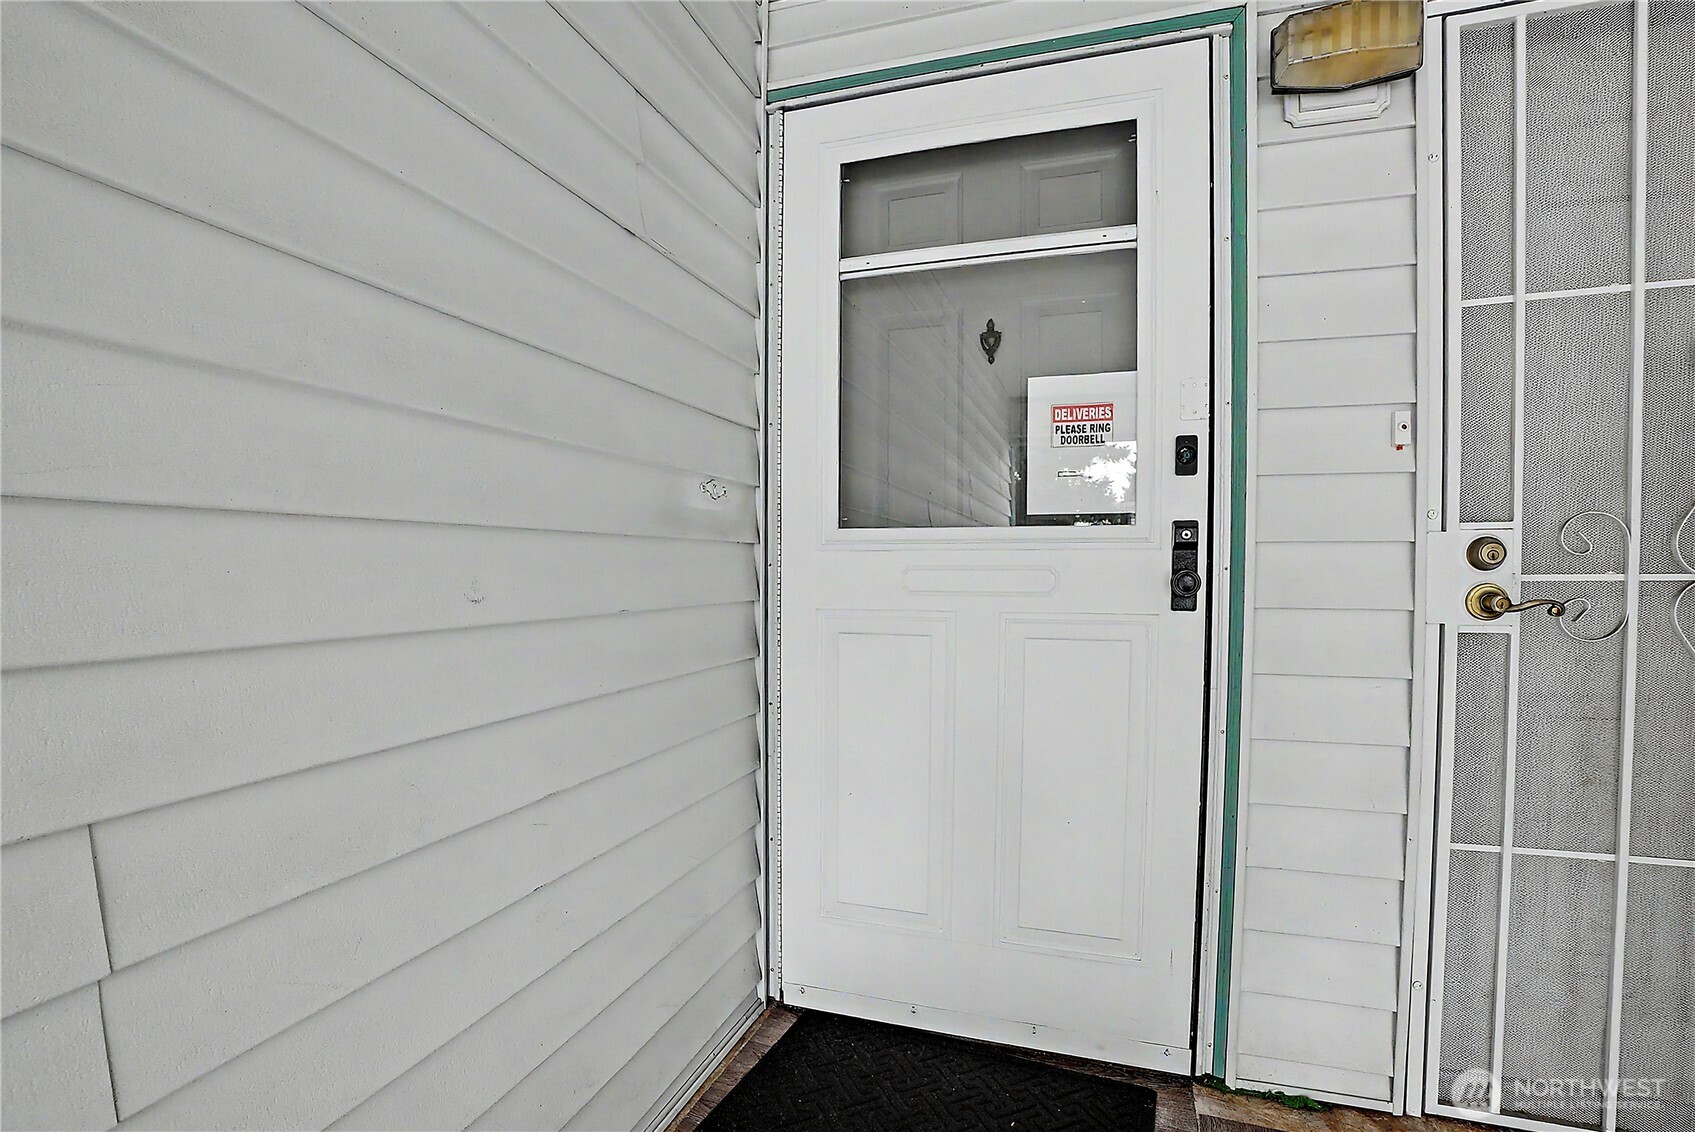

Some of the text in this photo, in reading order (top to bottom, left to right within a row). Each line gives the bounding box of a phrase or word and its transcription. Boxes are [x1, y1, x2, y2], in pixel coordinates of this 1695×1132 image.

[1054, 406, 1112, 421] DELIVERIES
[1055, 423, 1111, 434] PLEASE RING
[1060, 434, 1105, 445] DOORBELL
